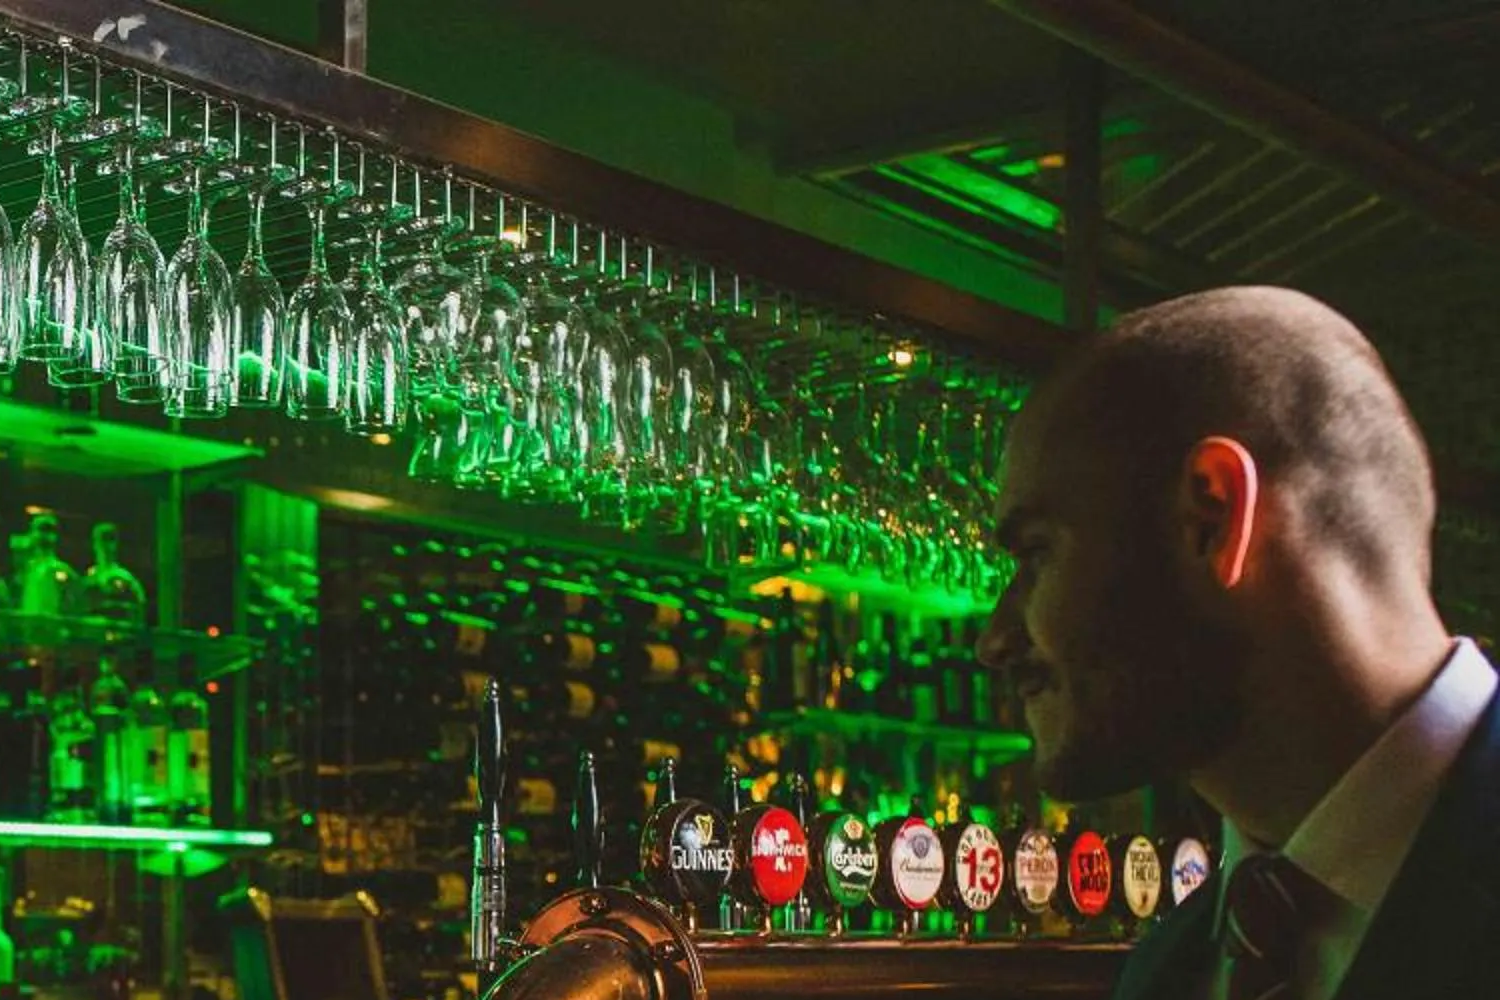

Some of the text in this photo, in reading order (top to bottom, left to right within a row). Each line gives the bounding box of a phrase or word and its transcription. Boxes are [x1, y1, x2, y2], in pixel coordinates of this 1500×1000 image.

[671, 845, 734, 871] GUINNES
[833, 845, 878, 874] Carlsber
[963, 847, 1001, 893] 13
[1019, 856, 1056, 873] PERON
